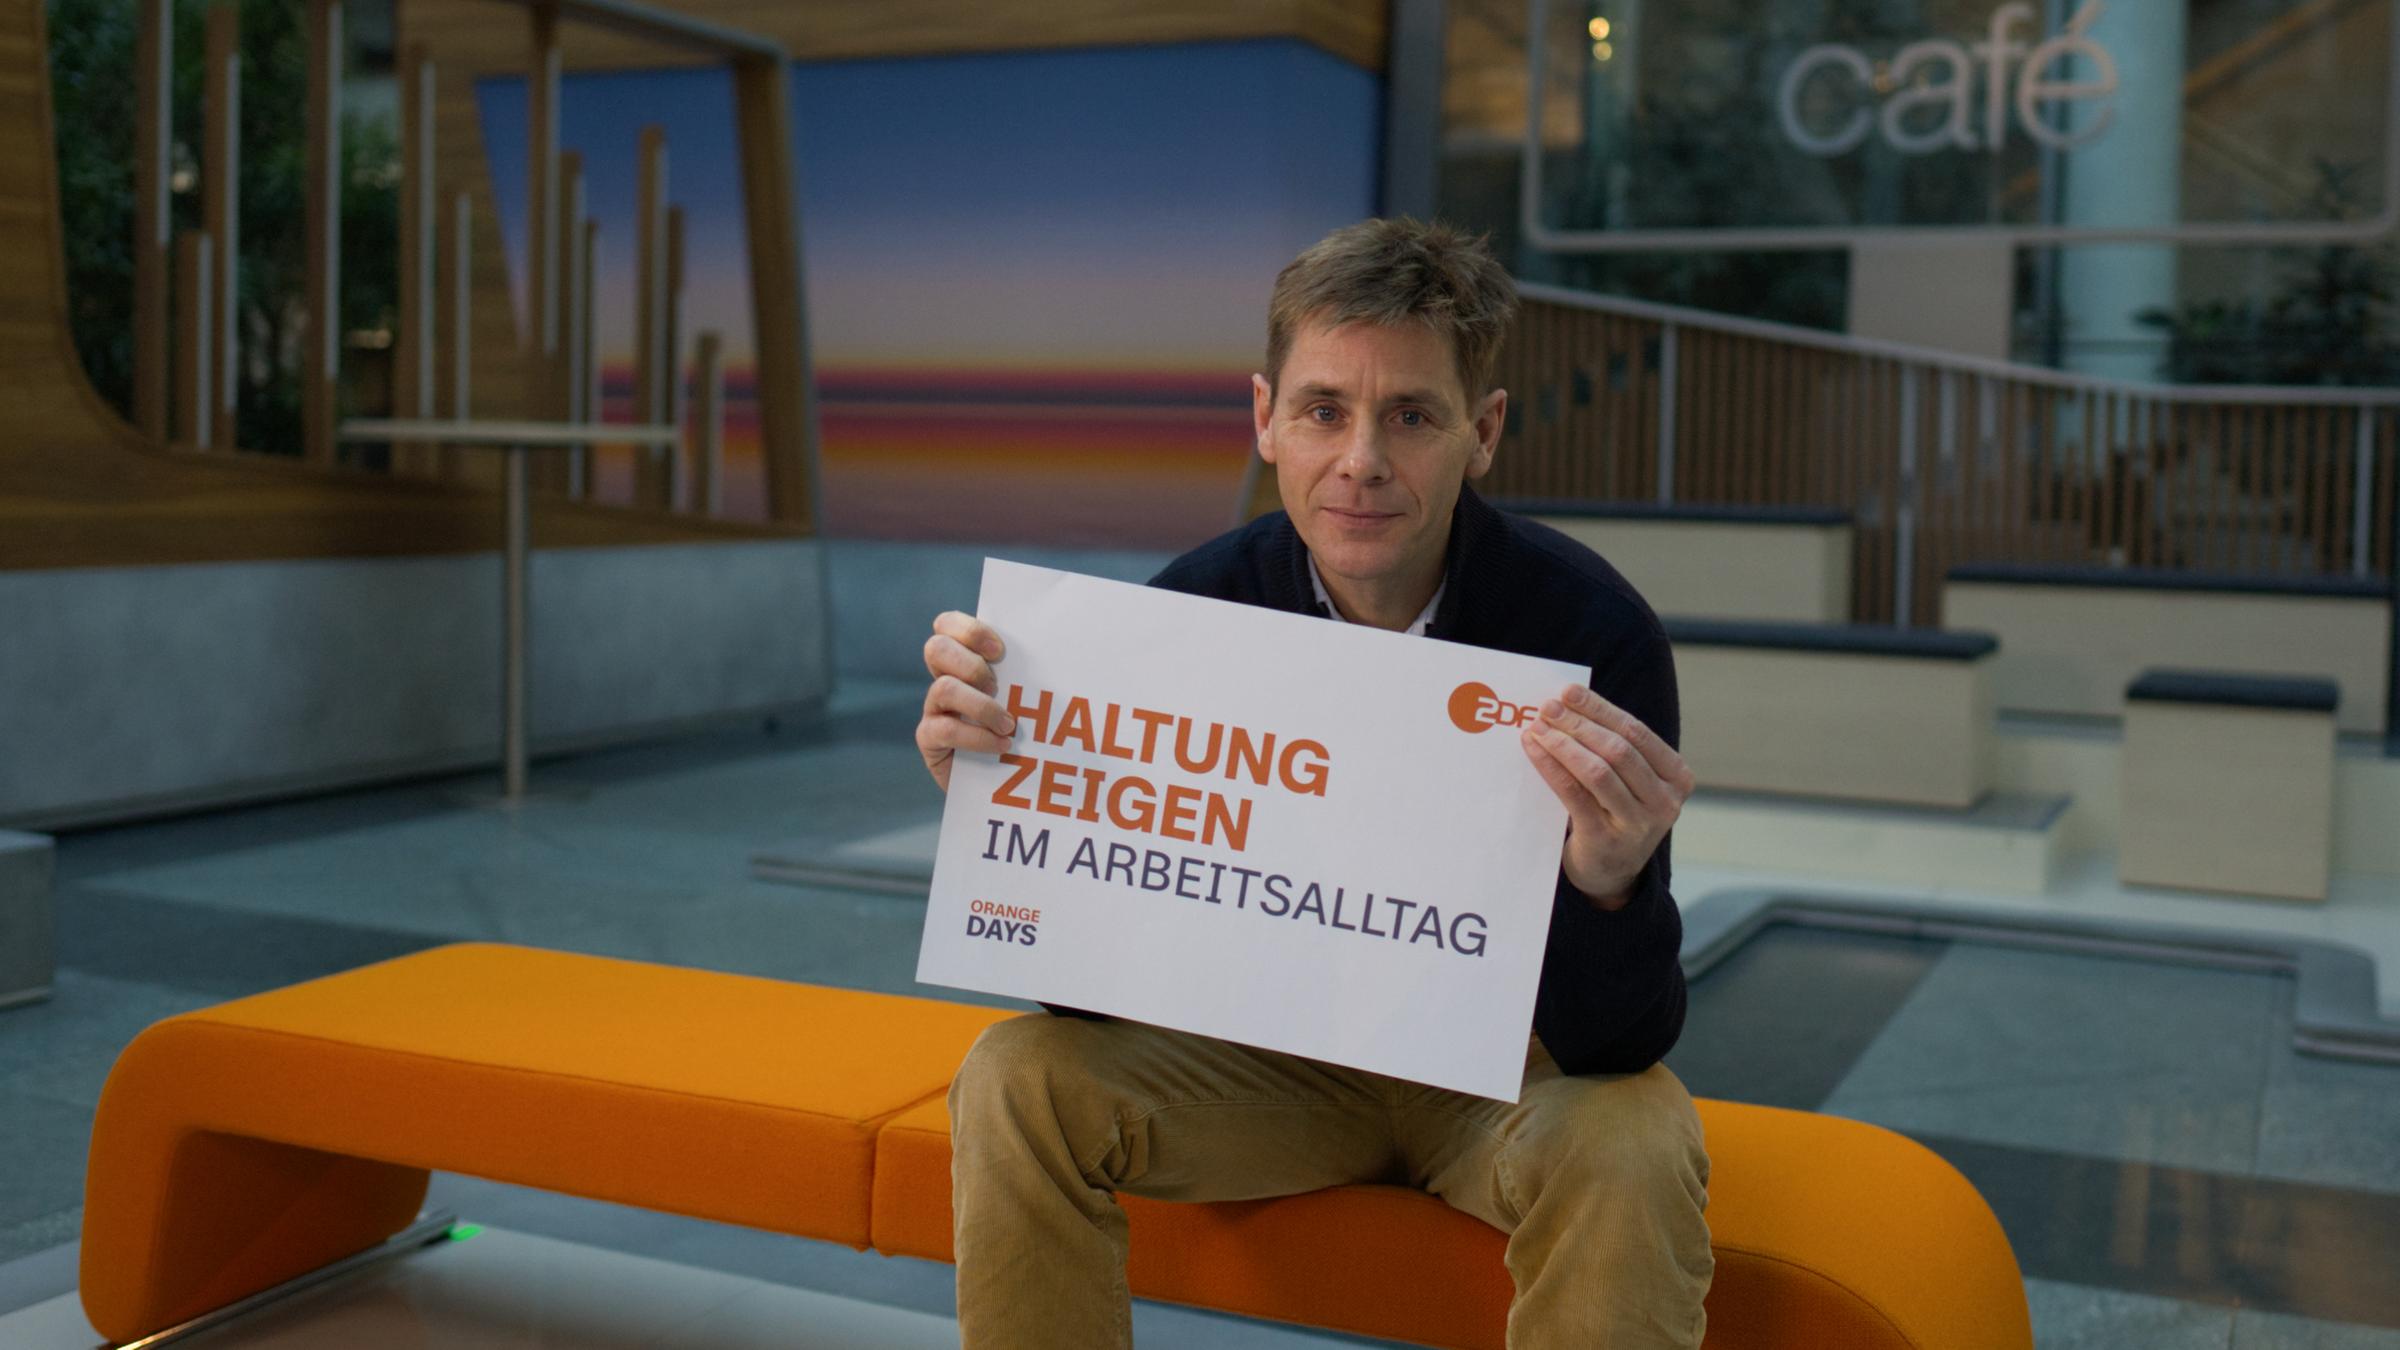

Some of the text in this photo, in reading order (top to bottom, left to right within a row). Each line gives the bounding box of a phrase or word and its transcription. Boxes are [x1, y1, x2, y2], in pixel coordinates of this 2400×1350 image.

[1779, 0, 2118, 155] café
[1006, 684, 1331, 798] HALTUNG
[991, 753, 1253, 852] ZEIGEN
[966, 915, 1038, 946] DAYS
[970, 899, 1041, 923] ORANGE
[981, 819, 1488, 958] IM ARBEITSALLTAG
